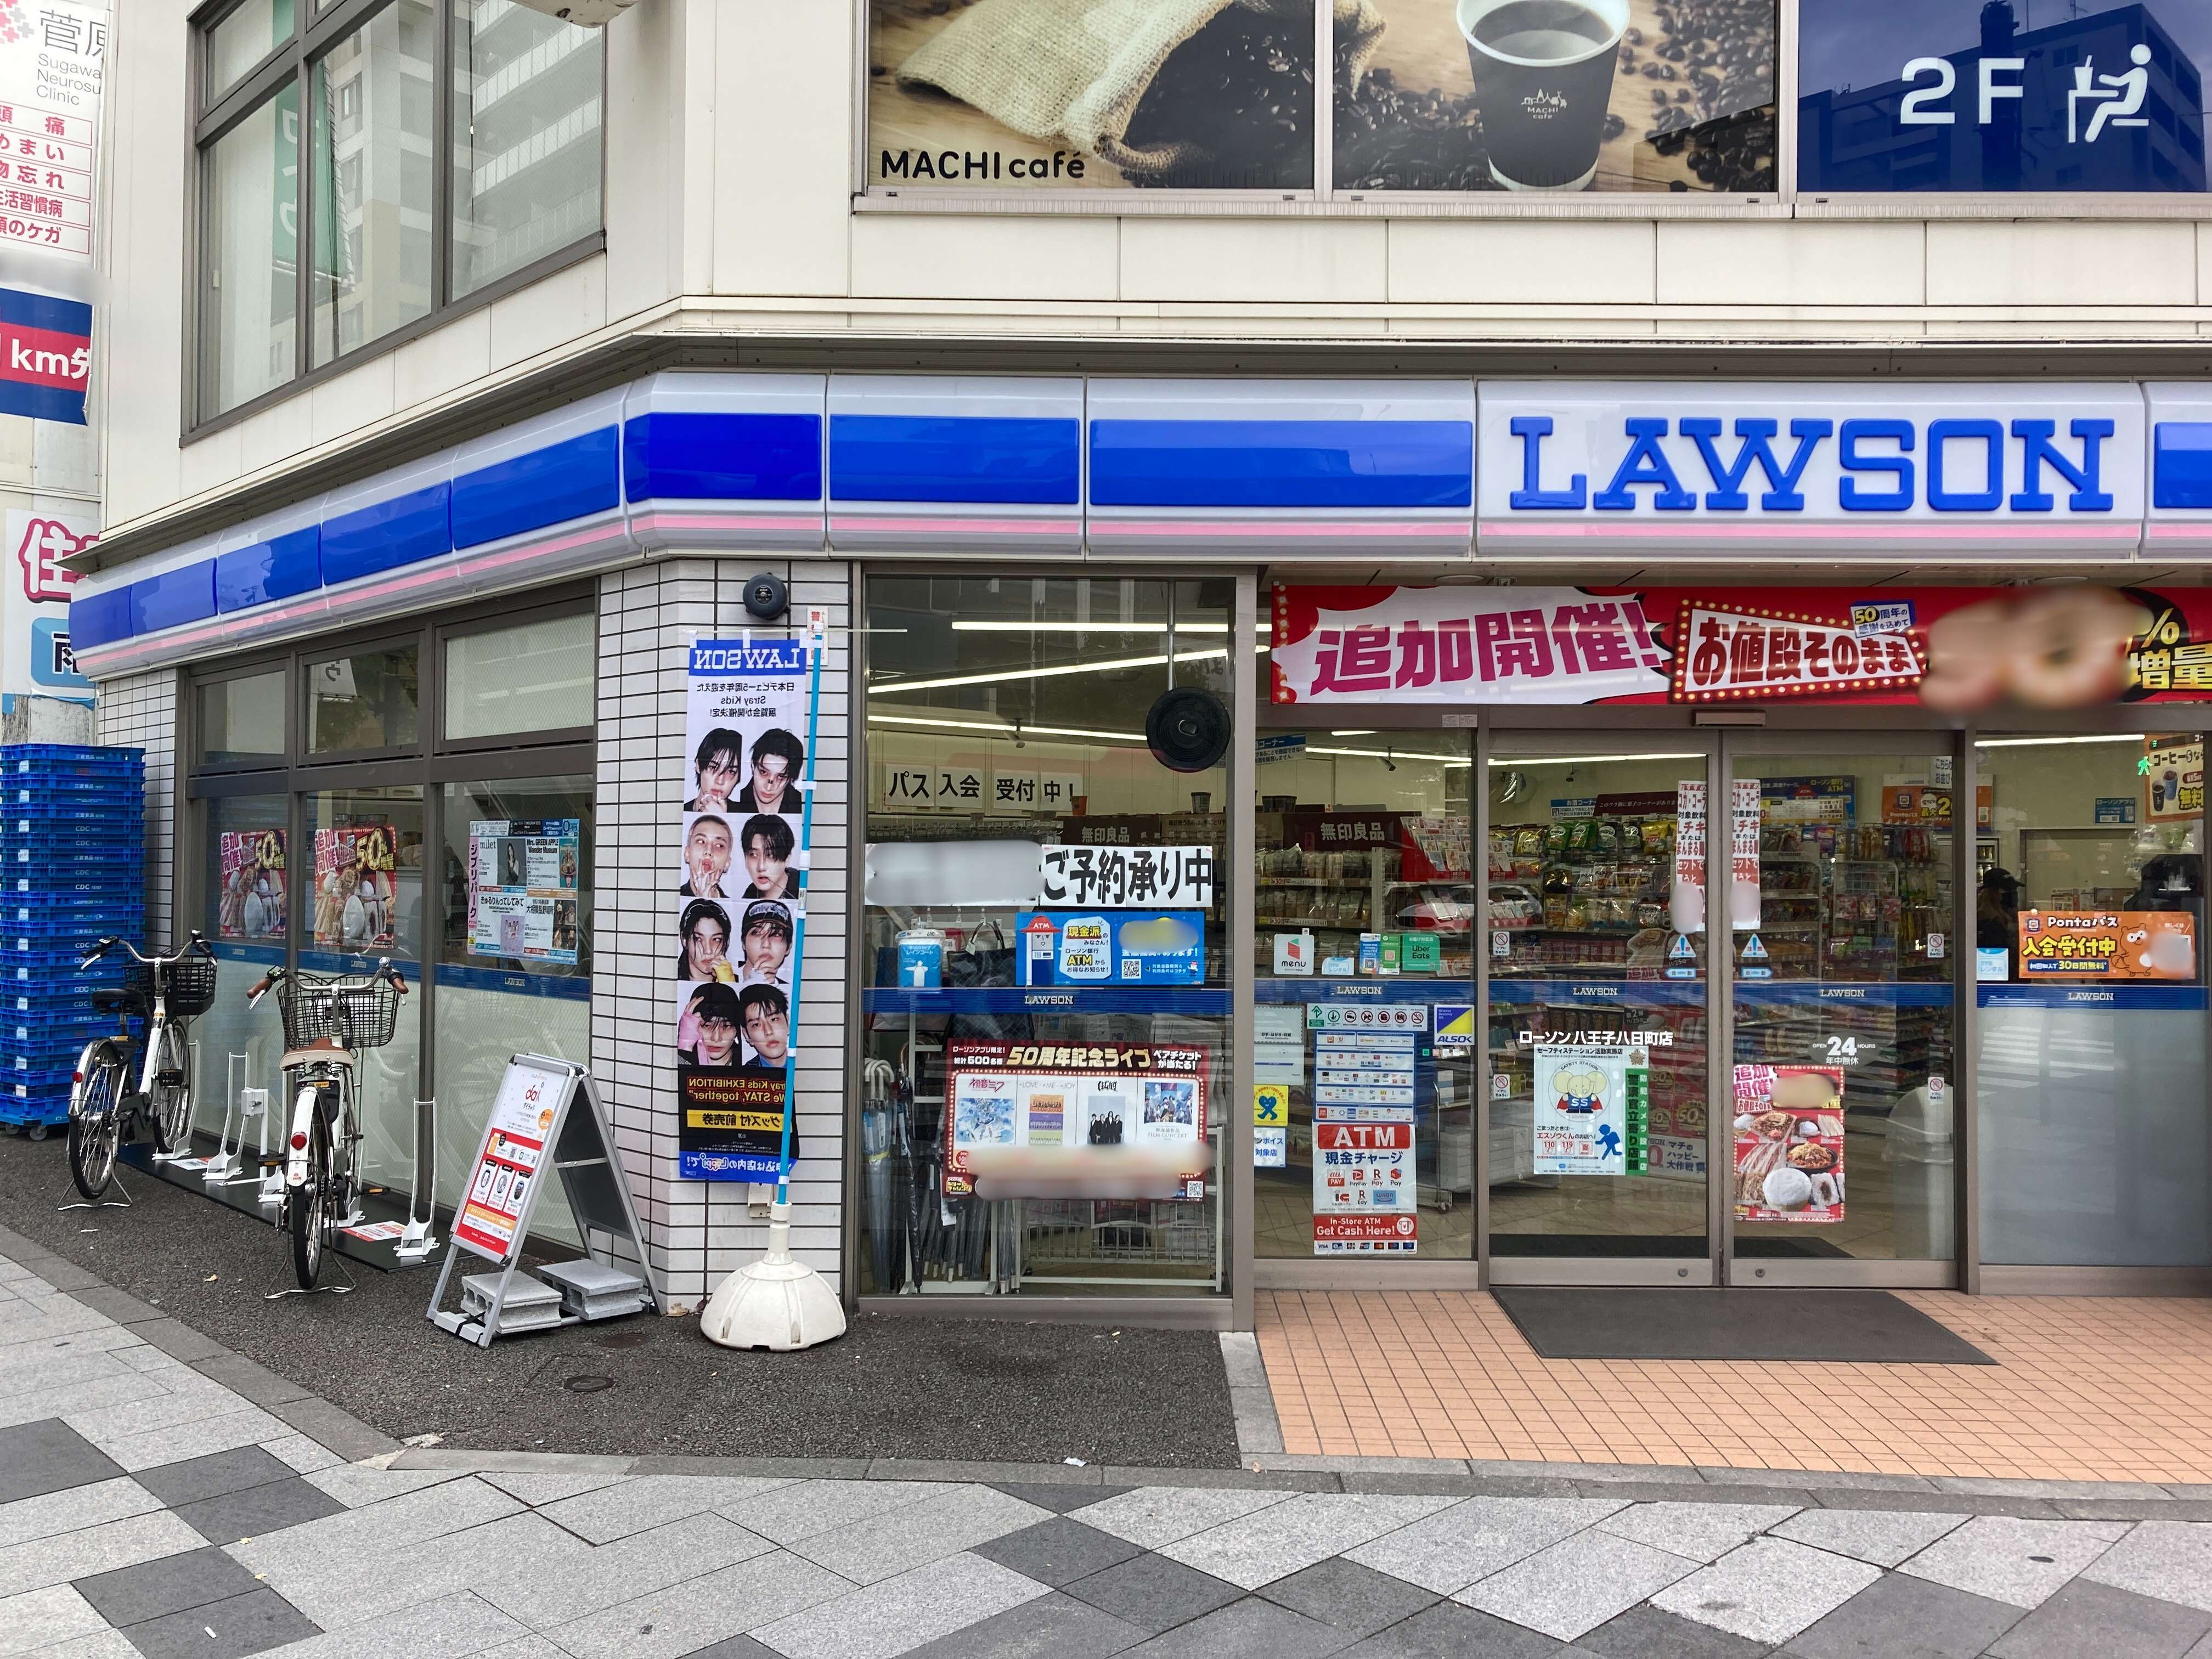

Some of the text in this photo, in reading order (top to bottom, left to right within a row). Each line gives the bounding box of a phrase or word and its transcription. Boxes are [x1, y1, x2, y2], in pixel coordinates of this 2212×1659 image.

[38, 53, 102, 80] Sugawa
[37, 68, 101, 95] Neurosu
[36, 84, 80, 105] Clinic
[1900, 57, 2025, 125] 2F
[881, 148, 1086, 180] MACHI café
[1509, 416, 2115, 512] LAWSON
[1854, 605, 1908, 625] 50周年の
[1310, 600, 1662, 696] 追加開催!
[1694, 616, 1914, 687] お値段そのまま
[1081, 826, 1130, 843] 無印良品
[1320, 822, 1385, 842] 無印良品
[479, 839, 496, 849] milet
[1043, 848, 1213, 905] ご予約承り中
[2047, 916, 2119, 928] Pontaパス
[1412, 944, 1430, 952] Uber
[2022, 935, 2117, 957] 入会受付中
[1336, 985, 1382, 995] LAWSON
[1572, 987, 1618, 996] LAWSON
[1820, 989, 1865, 997] LAWSON
[2067, 992, 2114, 1001] LAWSON
[1024, 995, 1073, 1005] LAWSON
[1519, 1031, 1674, 1046] ローソン八王子八日町店
[1827, 1036, 1858, 1056] 24
[952, 1046, 1006, 1054] ローソンアプリ限定!
[1006, 1046, 1152, 1068] 50周年記念ライブ
[1153, 1049, 1202, 1060] ペアチケット
[1158, 1060, 1196, 1070] が当たる!
[1825, 1057, 1859, 1065] 年中無休
[1735, 1065, 1769, 1081] 追加
[1571, 1098, 1589, 1107] SS
[1333, 1126, 1395, 1147] ATM
[1255, 1148, 1278, 1156] 対象店
[1325, 1150, 1404, 1165] 現金チャージ
[1317, 1225, 1395, 1235] Get Cash Here!
